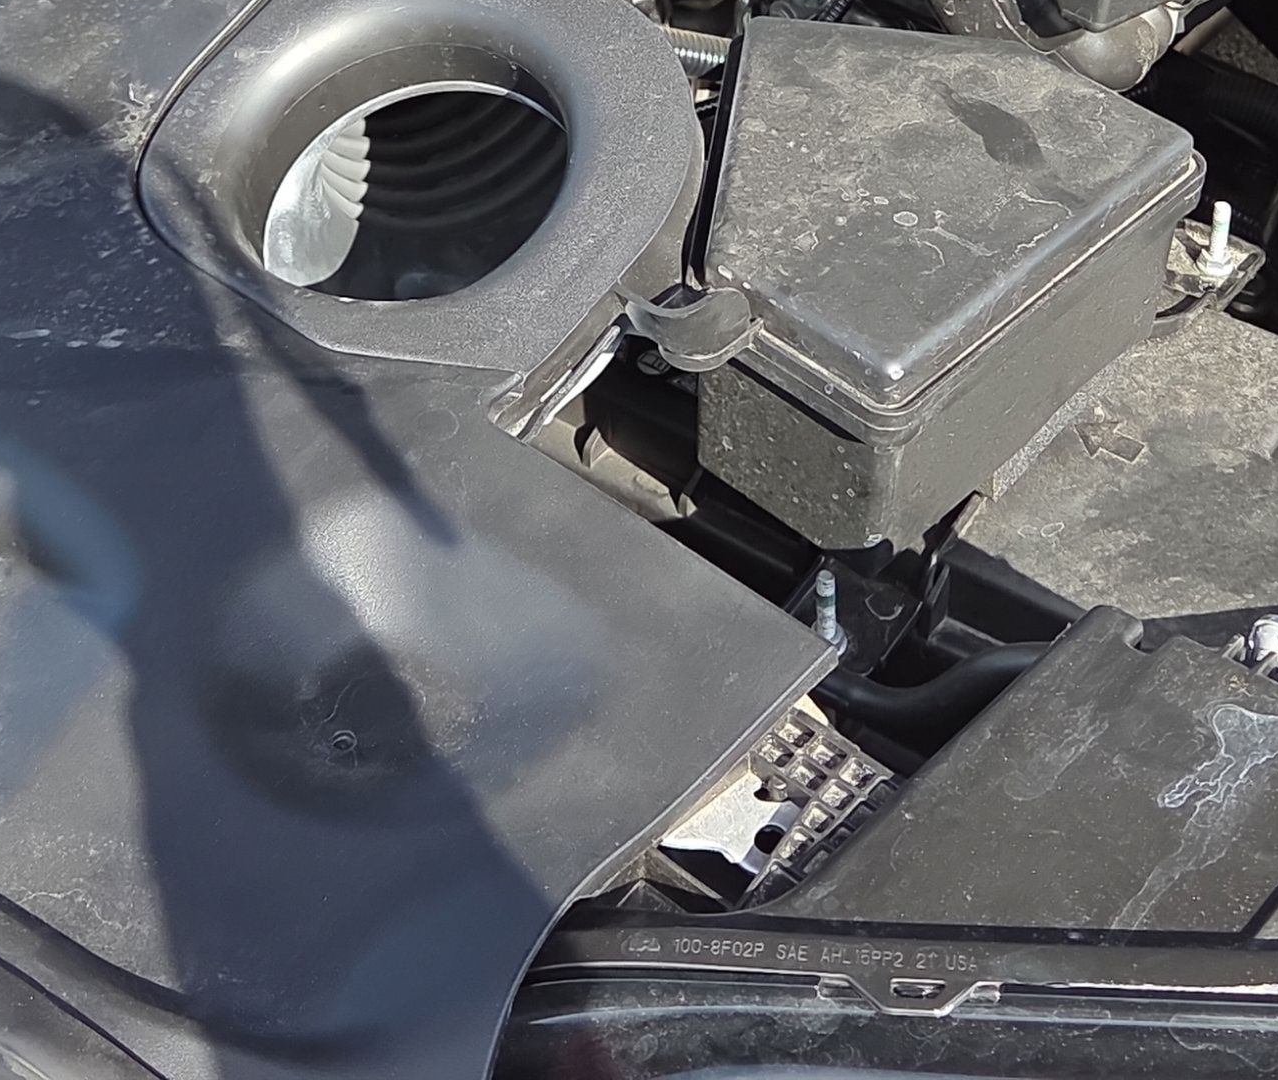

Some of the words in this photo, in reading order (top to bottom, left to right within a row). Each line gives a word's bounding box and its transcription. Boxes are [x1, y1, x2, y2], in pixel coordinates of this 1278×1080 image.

[673, 938, 764, 958] 100-8F02P
[776, 944, 809, 962] SAE
[945, 954, 978, 972] USA
